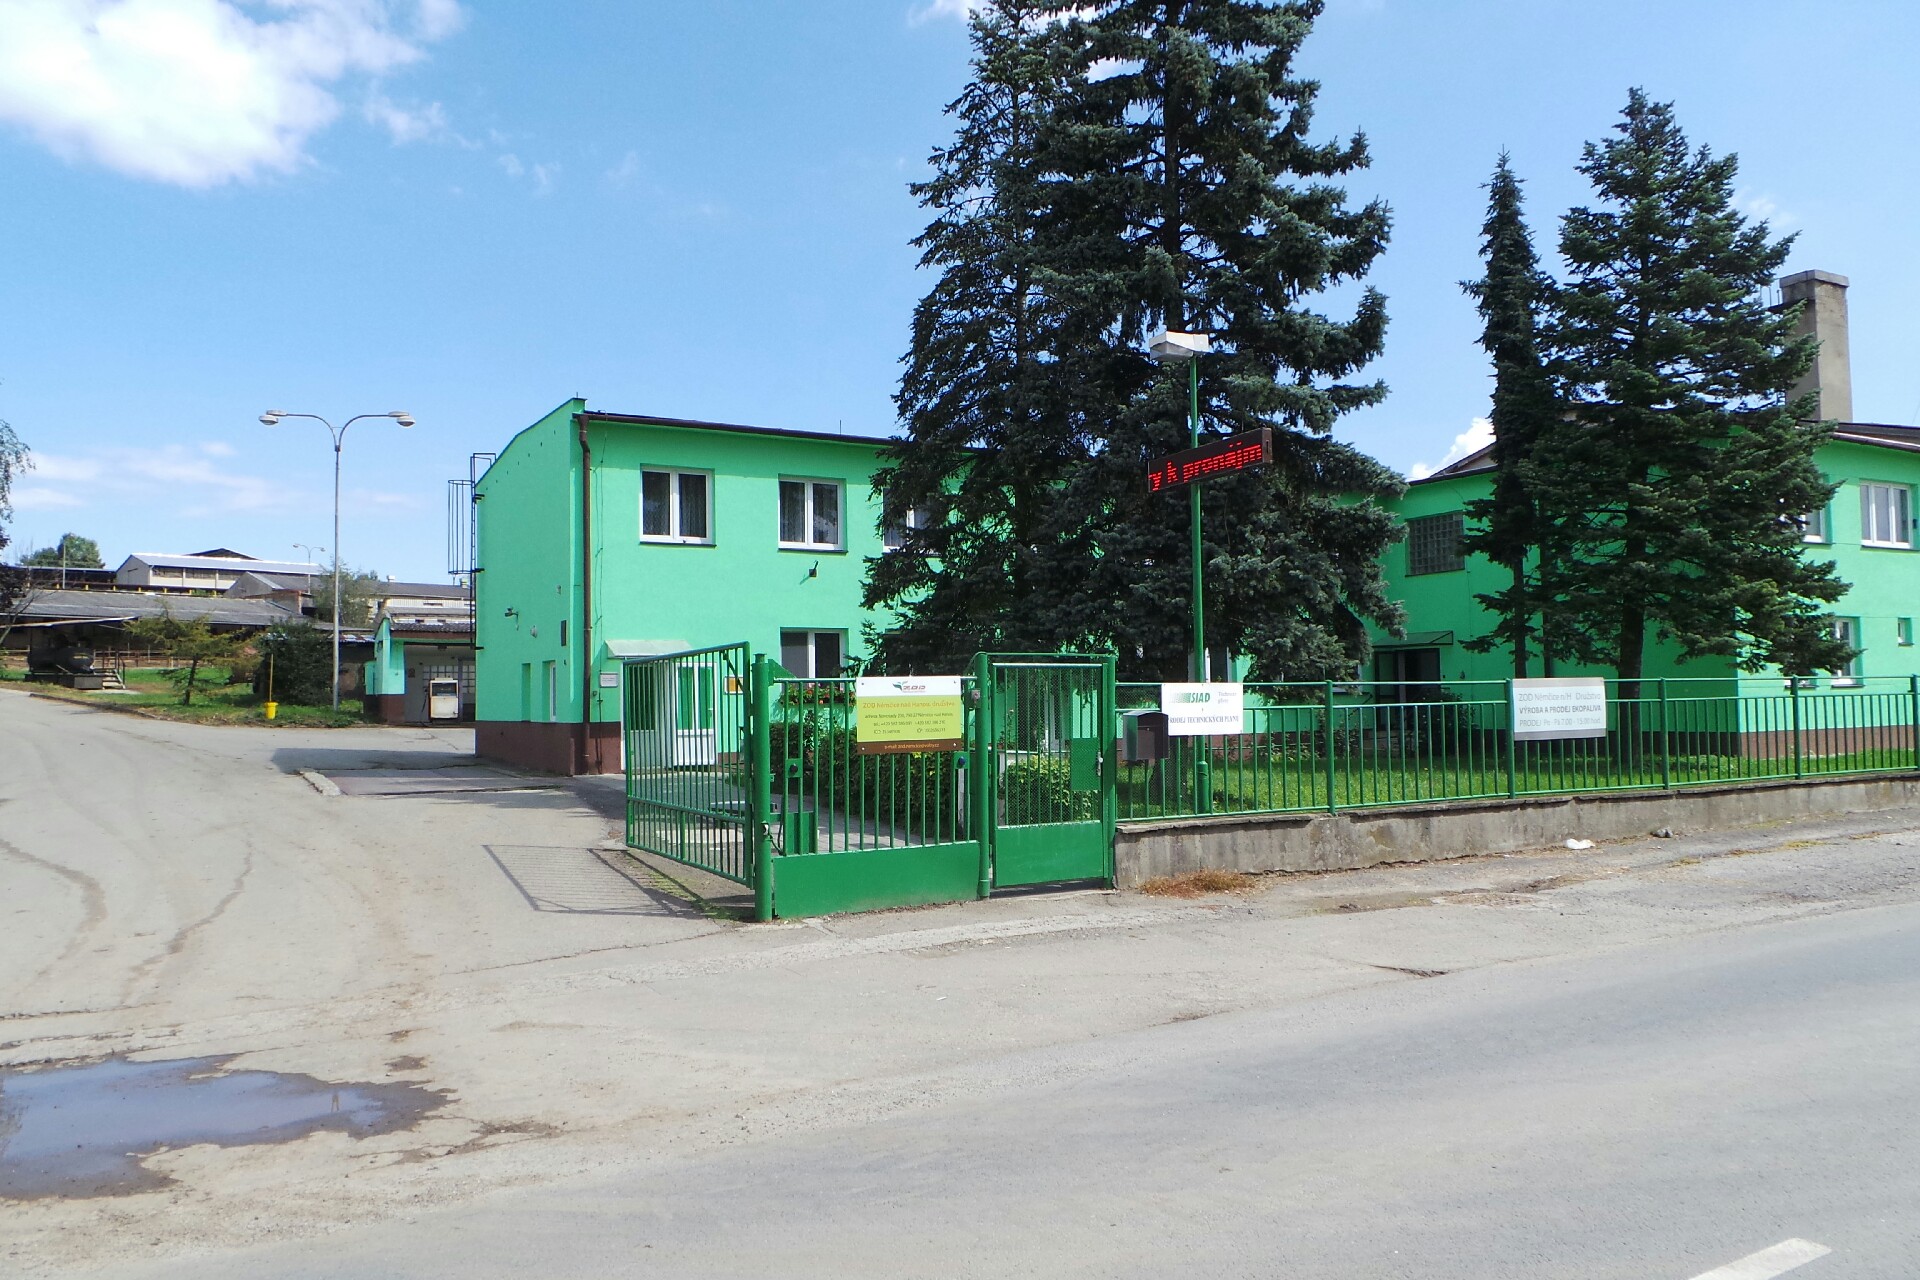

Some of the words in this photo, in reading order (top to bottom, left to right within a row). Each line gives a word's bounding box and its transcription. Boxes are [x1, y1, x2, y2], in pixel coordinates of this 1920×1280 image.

[1167, 461, 1178, 483] k
[1190, 692, 1210, 703] SIAD
[1518, 694, 1533, 702] ZOD
[1534, 692, 1560, 700] Němčice
[1576, 692, 1600, 700] Družstvo
[1520, 706, 1544, 714] VÝROBA
[1187, 714, 1224, 723] TECHNICKÝCH
